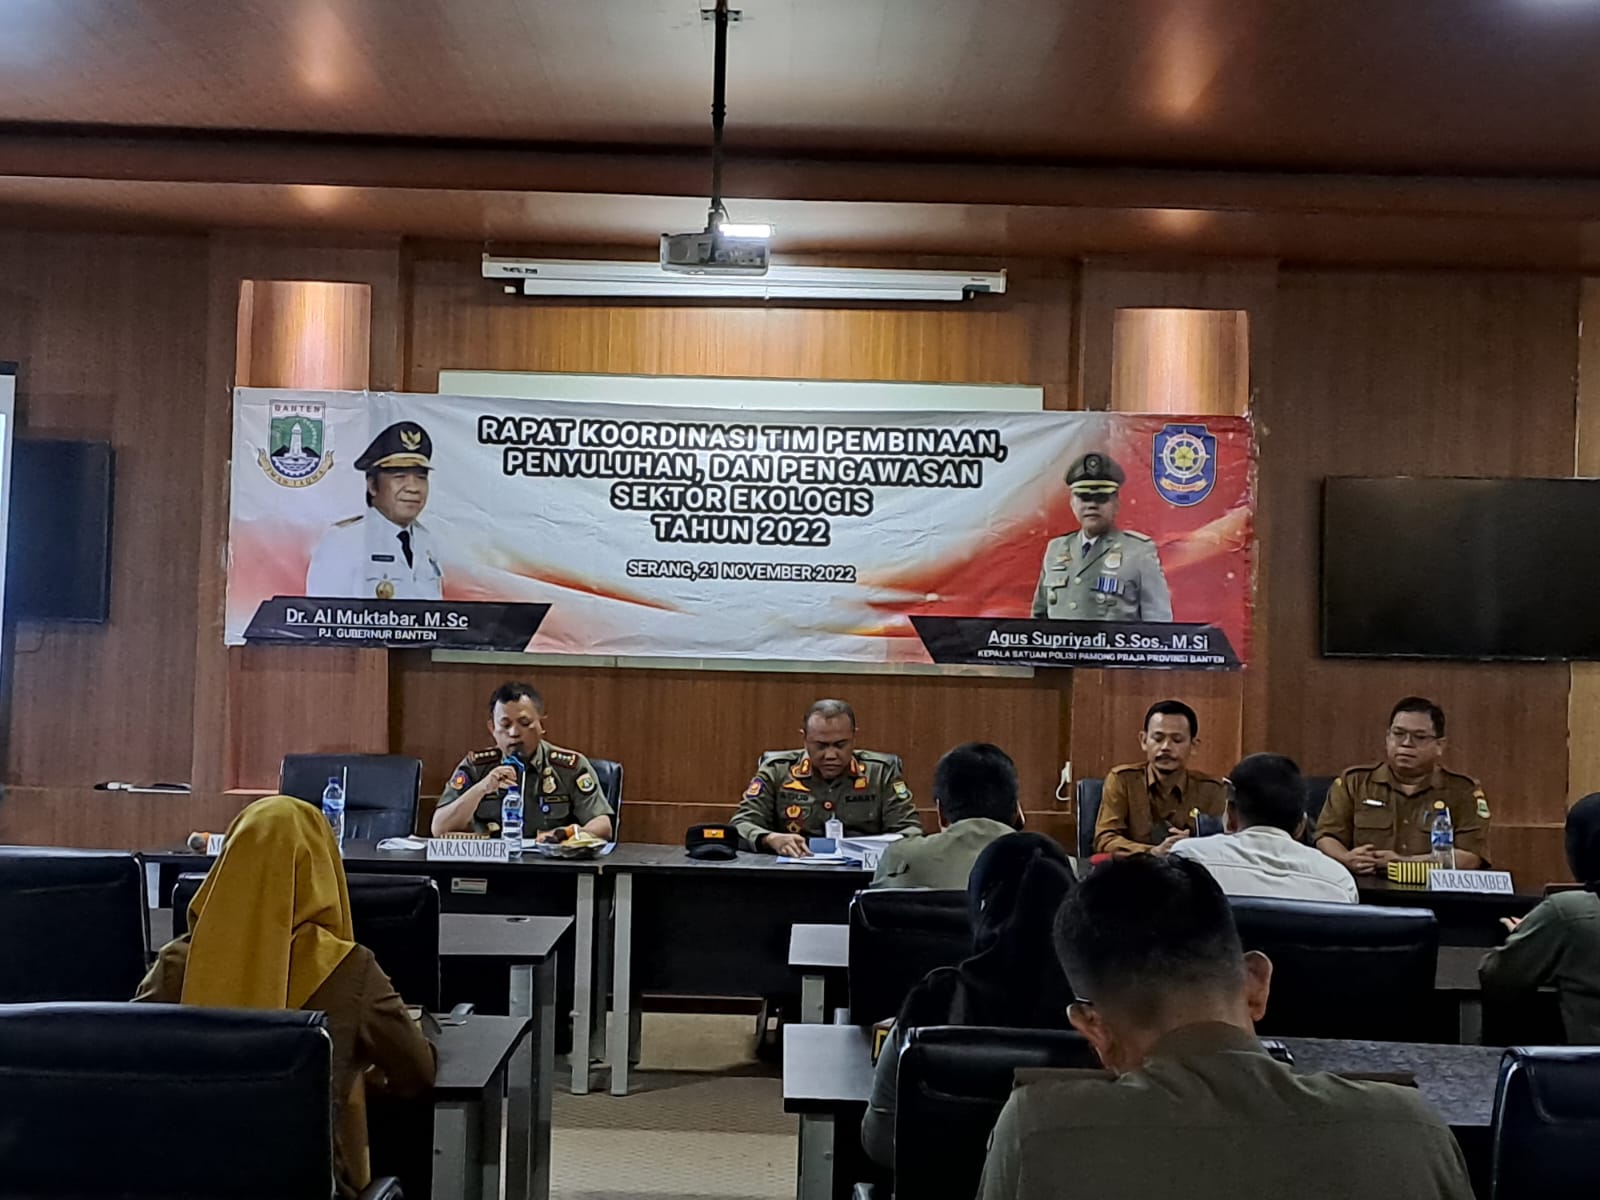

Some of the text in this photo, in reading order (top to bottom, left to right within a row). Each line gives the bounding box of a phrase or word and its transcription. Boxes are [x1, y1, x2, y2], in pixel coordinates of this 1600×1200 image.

[479, 418, 1006, 459] RAPAT KOORDINASI TIM PEMBINAAN,
[506, 451, 981, 486] PENYULUHAN, DAN PENGAWASAN
[612, 485, 872, 514] SEKTOR EKOLOGIS
[653, 516, 828, 544] TAHUN 2022
[626, 560, 857, 582] SERANG, 21 NOVEMBER 2022
[285, 607, 469, 628] Dr. Al Muktabar, M.Sc
[336, 628, 393, 640] GUBERNUR
[394, 630, 437, 641] BANTEN
[987, 629, 1029, 648] Agus
[1031, 631, 1111, 650] Supriyadi,
[1172, 635, 1209, 650] M.Si
[977, 649, 1225, 664] KEPALA SATUAN POLISI PAMONG PRAJA PROVINSI BANTEN
[428, 840, 508, 858] NARASUMBER
[1430, 871, 1513, 891] NARASUMBER
